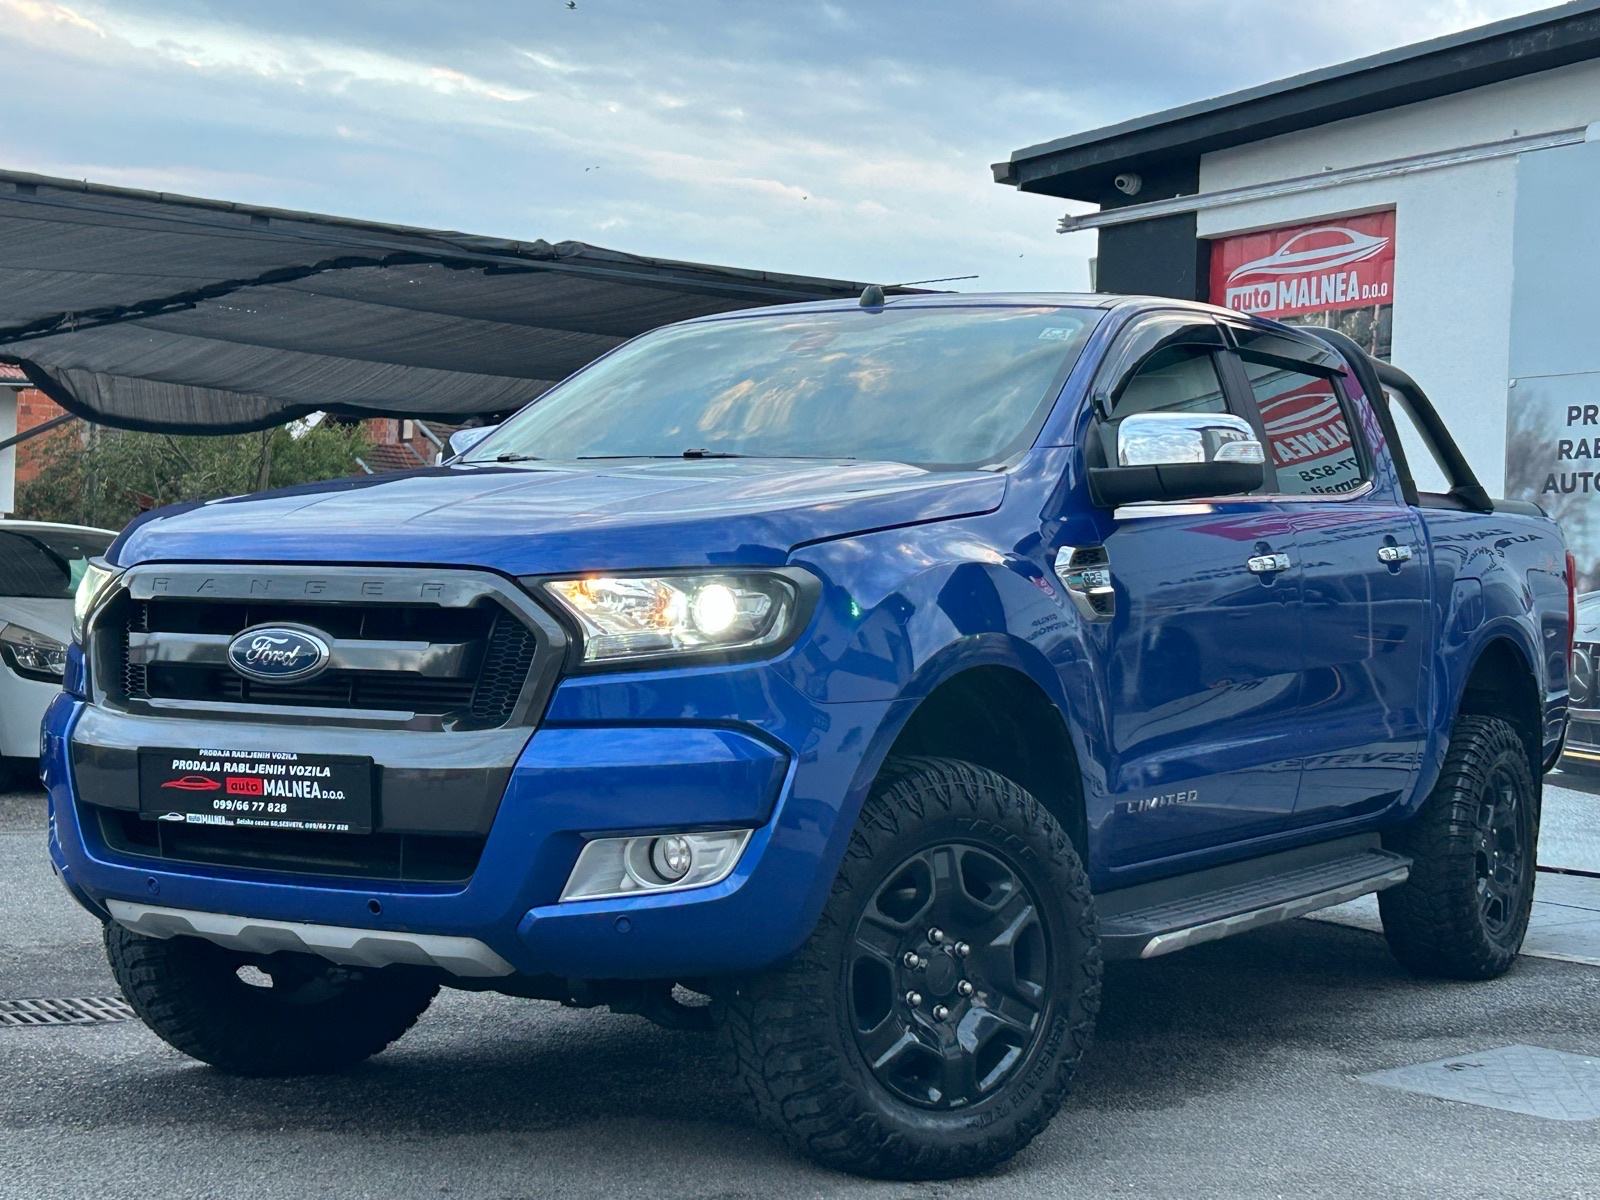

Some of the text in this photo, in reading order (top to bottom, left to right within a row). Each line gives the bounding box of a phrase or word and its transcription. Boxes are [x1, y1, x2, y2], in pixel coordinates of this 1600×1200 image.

[1231, 287, 1272, 312] auto
[1278, 271, 1360, 310] MALNEA
[151, 577, 446, 598] RANGER
[246, 635, 301, 667] Ford
[199, 749, 298, 761] PRODAJA RABLJENIH VOZILA
[172, 759, 331, 777] PRODAJA RABLJENIH VOZILA
[230, 779, 345, 800] auto MALNEA D.O.O.
[213, 799, 287, 813] 099/66 77 828
[1127, 790, 1198, 813] LIMITED
